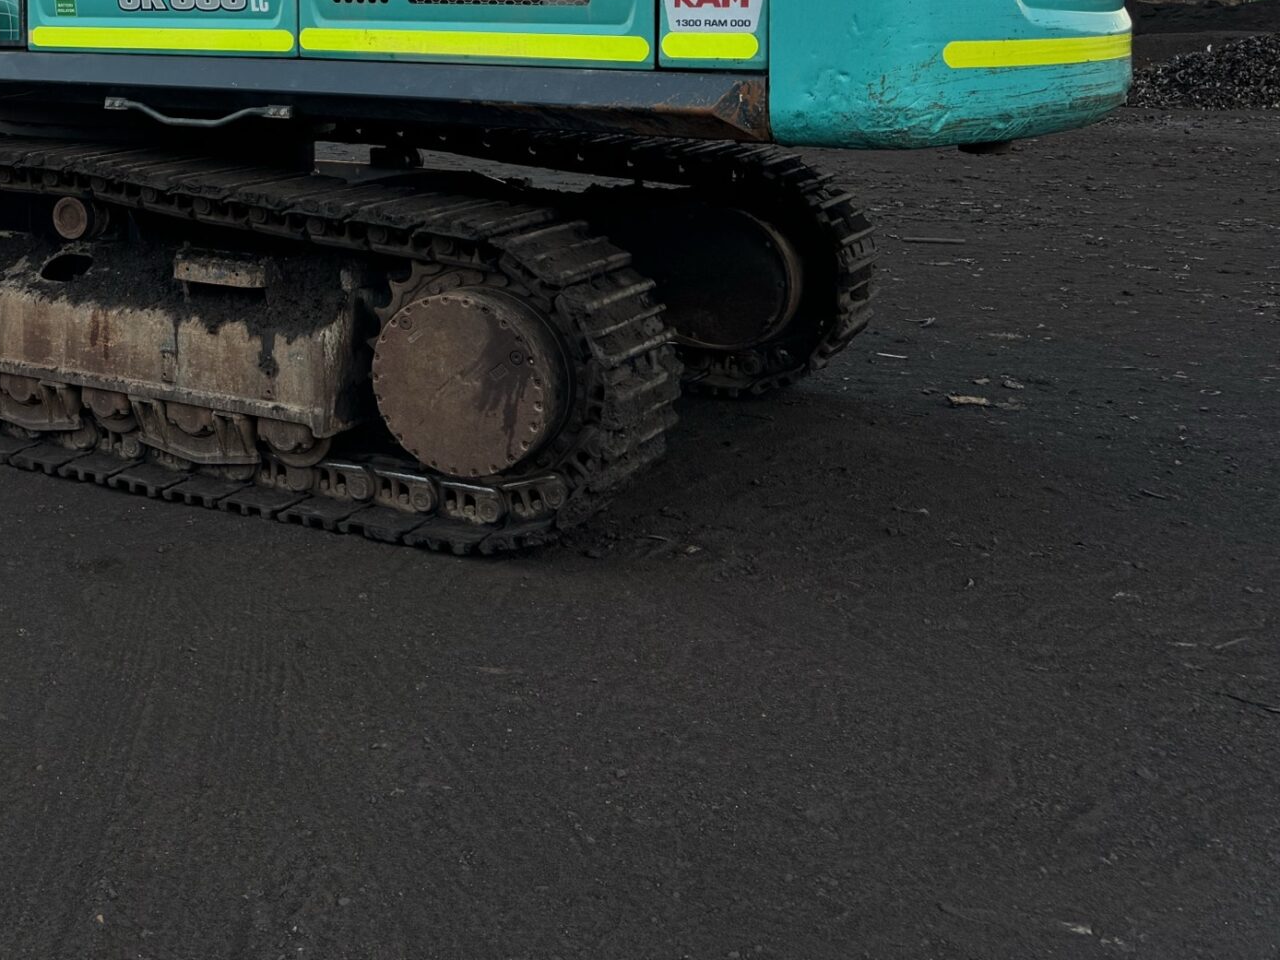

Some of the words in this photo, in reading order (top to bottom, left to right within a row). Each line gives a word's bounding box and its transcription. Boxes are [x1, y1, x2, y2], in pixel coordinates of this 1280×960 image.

[676, 19, 701, 27] 1300
[704, 19, 727, 27] RAM
[730, 19, 751, 27] 000
